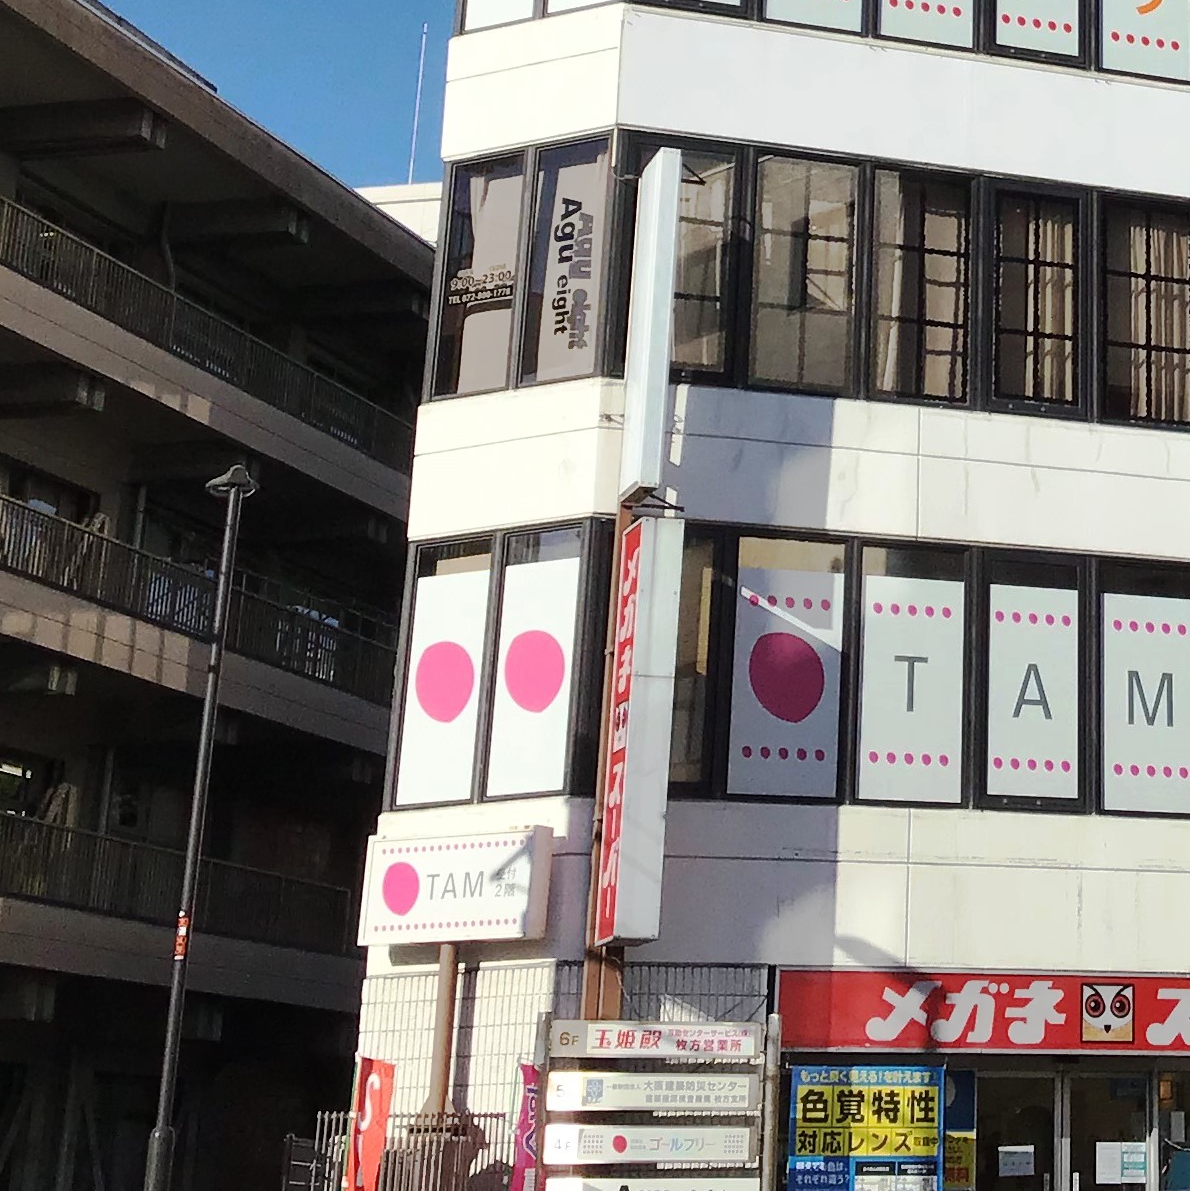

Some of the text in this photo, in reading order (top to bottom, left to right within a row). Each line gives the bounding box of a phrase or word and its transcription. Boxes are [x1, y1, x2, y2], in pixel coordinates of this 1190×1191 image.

[551, 196, 583, 336] Agu eight
[892, 655, 1176, 728] TAM
[426, 870, 485, 901] TAM
[864, 979, 1068, 1045] メガネ
[559, 1031, 579, 1047] 6F
[591, 1028, 662, 1050] 玉姫殿
[800, 1089, 936, 1125] 色覚特性
[797, 1130, 914, 1154] 対応レンズ
